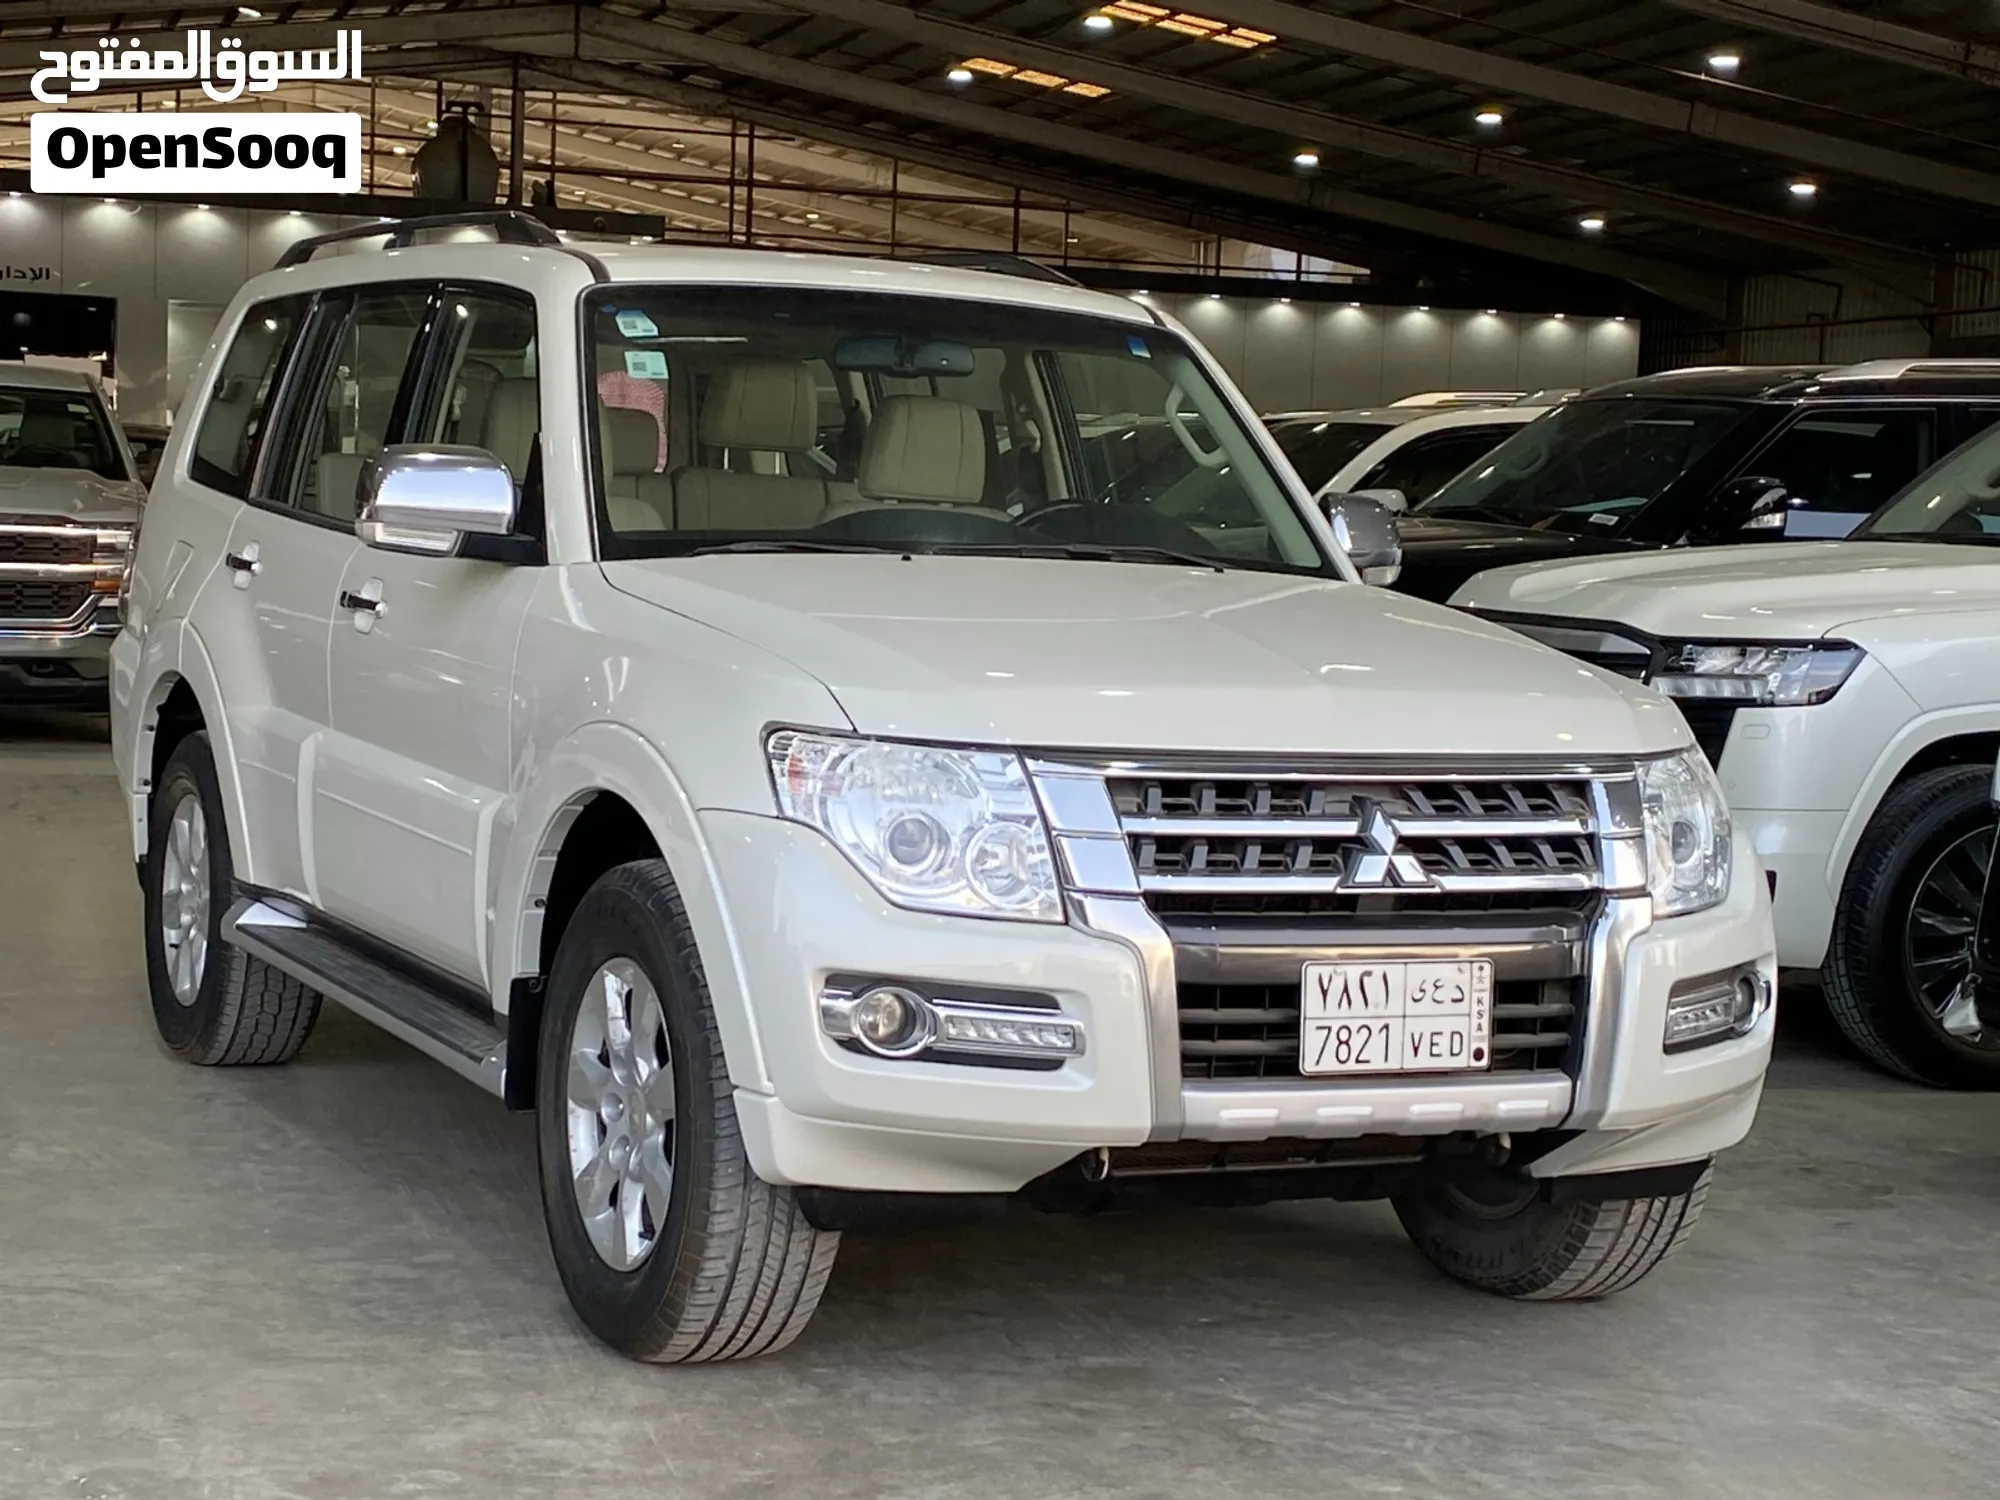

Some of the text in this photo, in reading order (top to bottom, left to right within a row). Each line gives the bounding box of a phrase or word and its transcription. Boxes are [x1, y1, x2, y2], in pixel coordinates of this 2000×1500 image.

[1318, 969, 1390, 1011] ٧٨٢١
[1476, 996, 1485, 1033] KSA
[1315, 1023, 1464, 1066] 7821 VED
